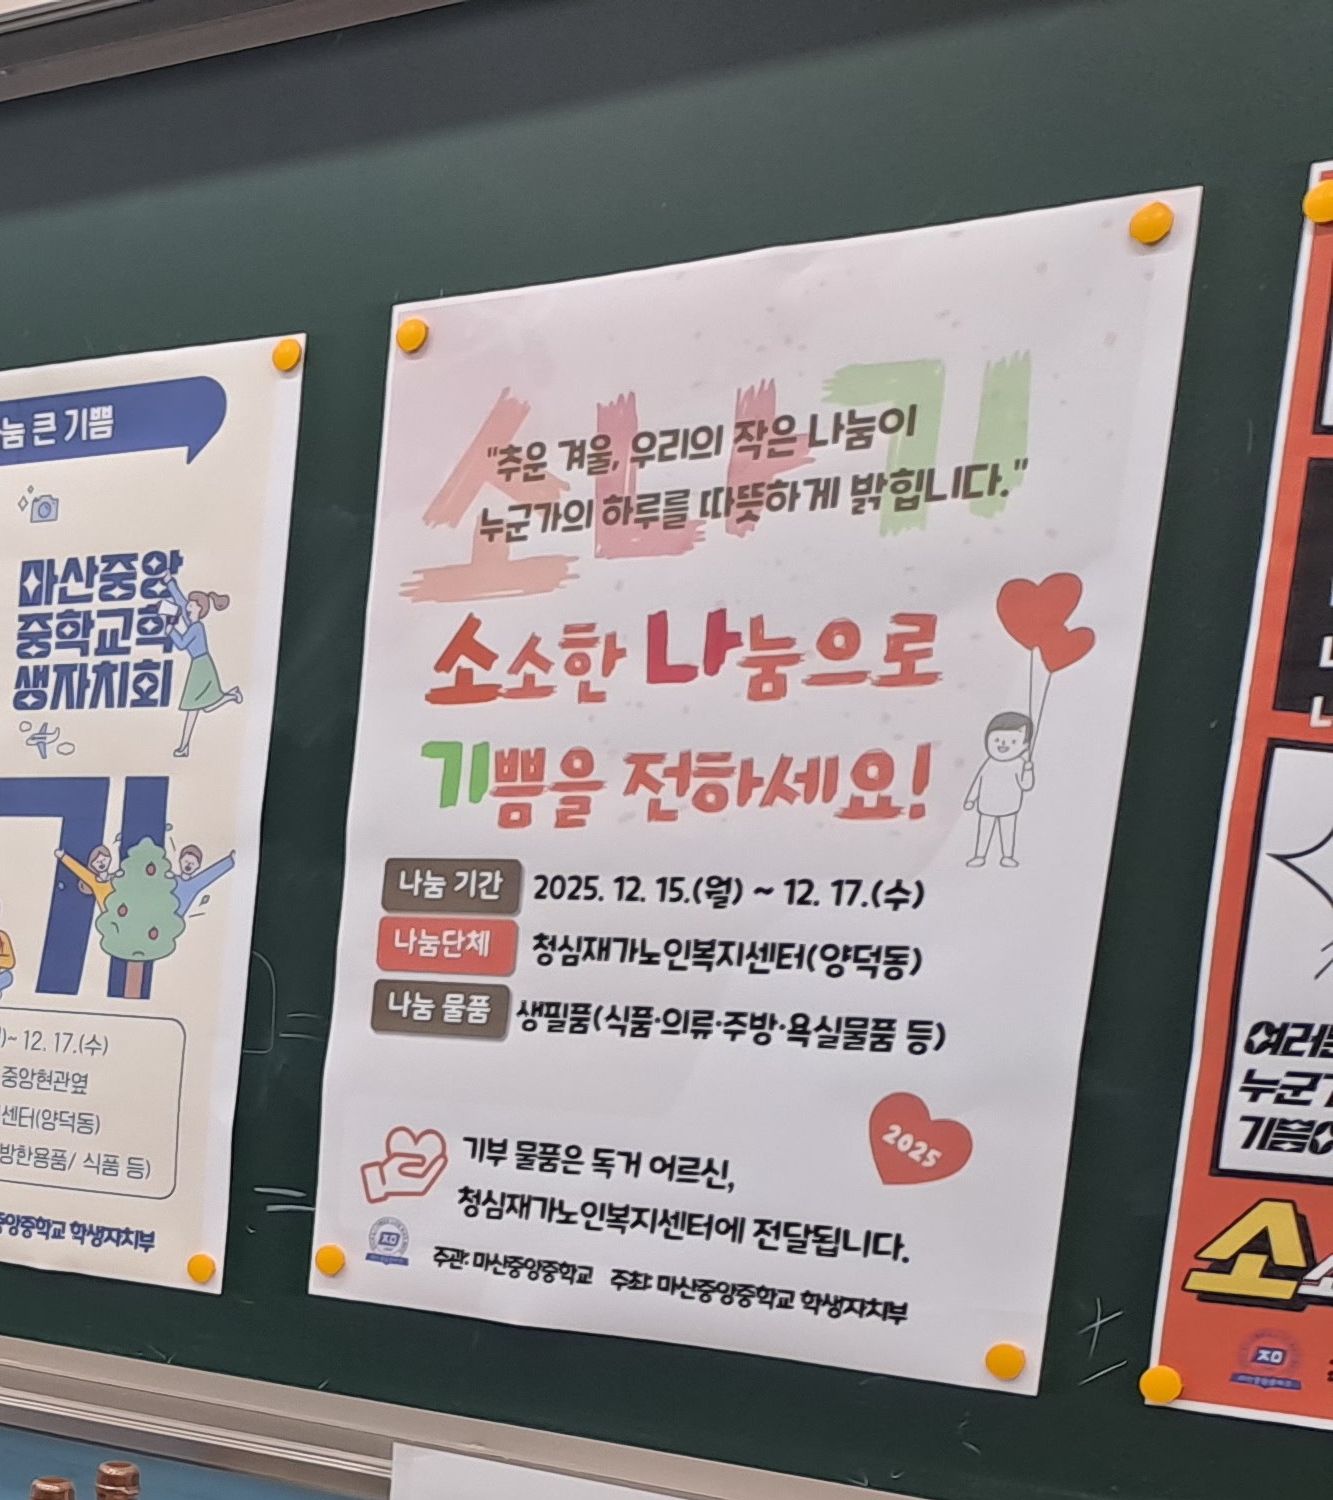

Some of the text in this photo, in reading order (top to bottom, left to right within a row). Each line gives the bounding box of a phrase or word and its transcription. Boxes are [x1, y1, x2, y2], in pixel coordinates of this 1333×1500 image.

[33, 411, 57, 447] 큰
[64, 405, 115, 442] 기쁨
[486, 405, 918, 482] "추운 겨울, 우리의 작은 나눔이
[480, 459, 1028, 543] 누군가의 하루를 따뜻하게 밝힙니다."
[19, 549, 184, 606] 마산중앙
[16, 604, 175, 660] 중학교학
[425, 609, 942, 703] 소소한 나눔으로
[13, 658, 174, 711] 생자치회
[421, 742, 931, 829] 기쁨을 전하세요!
[399, 870, 504, 902] 나눔 기간
[533, 874, 605, 903] 2025.
[612, 876, 647, 903] 12.
[783, 879, 820, 906] 12.
[394, 928, 490, 959] 나눔단체
[532, 932, 924, 979] 청심재가노인복지센터(양덕동)
[388, 990, 490, 1026] 나눔 물품
[24, 1030, 47, 1051] 12.
[907, 1020, 946, 1054] 등)
[1, 1066, 87, 1095] 중앙현관옆
[0, 1143, 76, 1171] 방한용품/
[83, 1152, 119, 1176] 식품
[127, 1157, 150, 1180] 등)
[463, 1137, 735, 1193] 기부 물품은 독거 어르신,
[882, 1124, 942, 1169] 2025
[70, 1221, 155, 1252] 학생자치부
[458, 1185, 910, 1264] 청심재가노인복지센터에 전달됩니다.
[472, 1252, 908, 1326] 마산중앙중학교 마산중앙중학교 학생자치부
